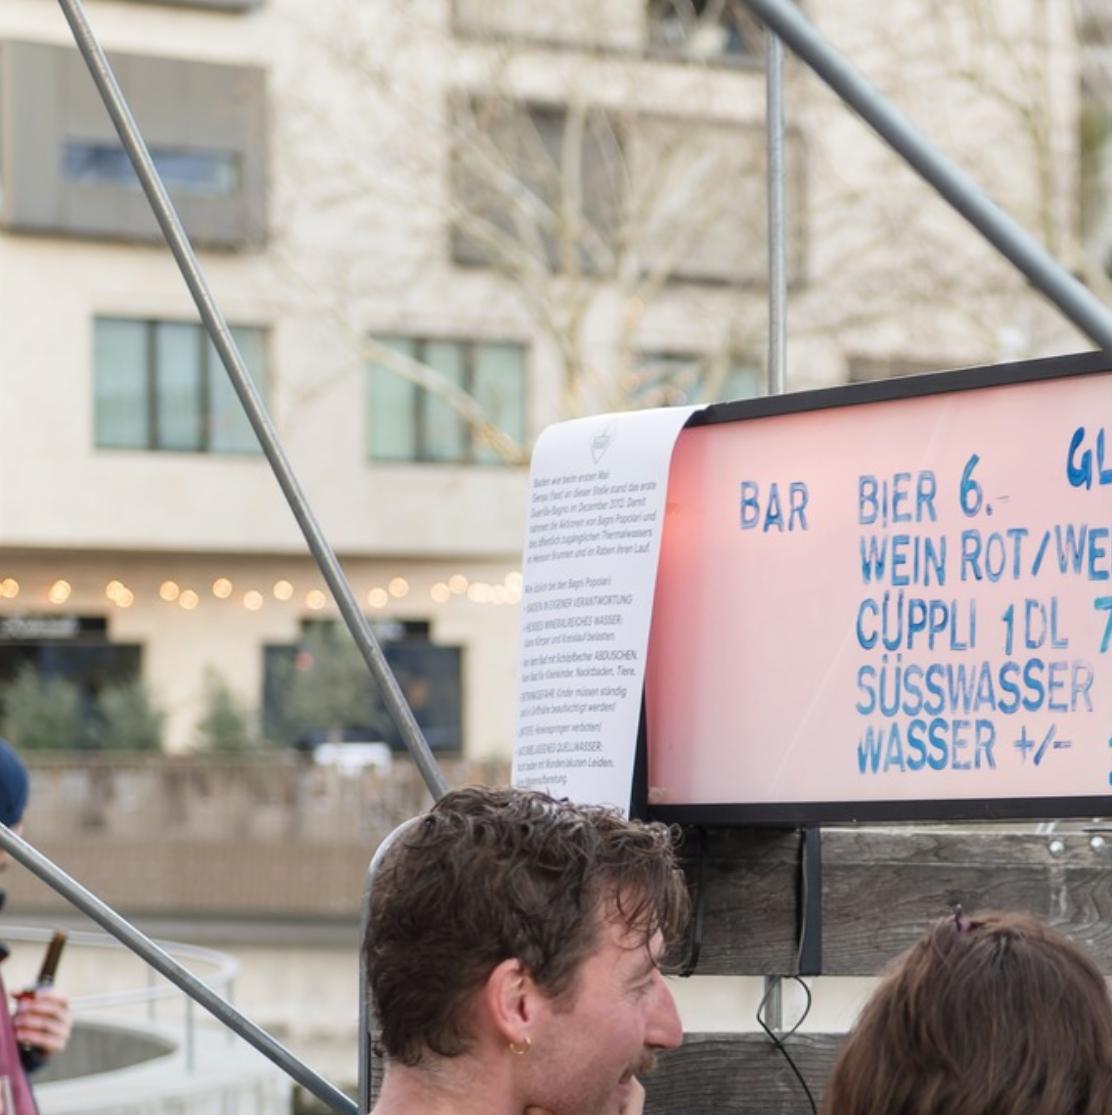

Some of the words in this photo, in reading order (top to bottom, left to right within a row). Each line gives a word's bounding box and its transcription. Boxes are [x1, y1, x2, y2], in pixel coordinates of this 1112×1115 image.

[740, 480, 809, 532] BAR
[858, 470, 938, 528] BIER
[860, 533, 947, 587] WEIN
[856, 589, 977, 651] CÜPPLI
[855, 653, 1094, 717] SÜSSWASSER
[857, 717, 997, 775] WASSER
